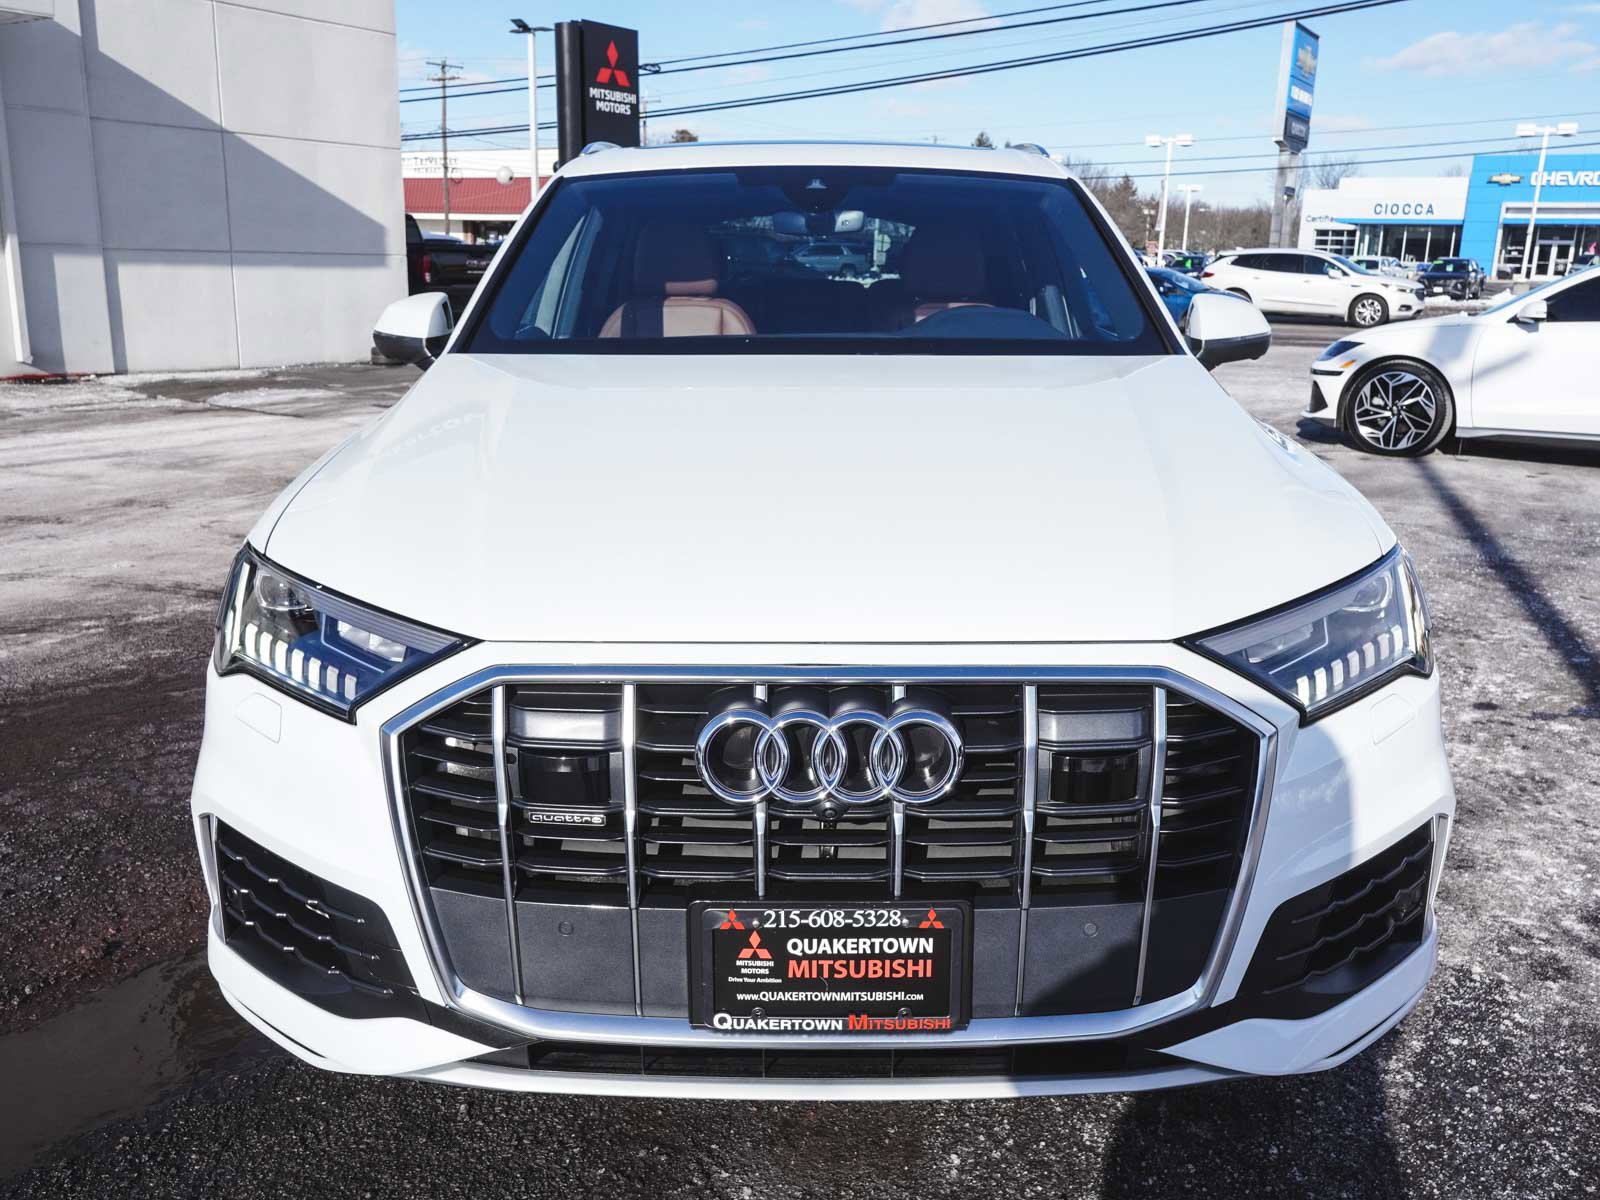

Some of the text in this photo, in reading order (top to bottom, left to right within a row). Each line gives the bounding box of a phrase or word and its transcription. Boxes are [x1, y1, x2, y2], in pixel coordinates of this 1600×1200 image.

[589, 87, 637, 105] MITSUBISHI
[596, 100, 631, 115] MOTORS
[1373, 203, 1435, 215] CIOCCA
[1305, 214, 1335, 223] Certifie
[532, 814, 602, 824] quattro
[763, 909, 902, 929] 215-608-5328
[786, 938, 934, 956] QUAKERTOWN
[787, 959, 933, 979] MITSUBISHI
[713, 1012, 951, 1031] QUAKERTOWN MITSUBISHI
